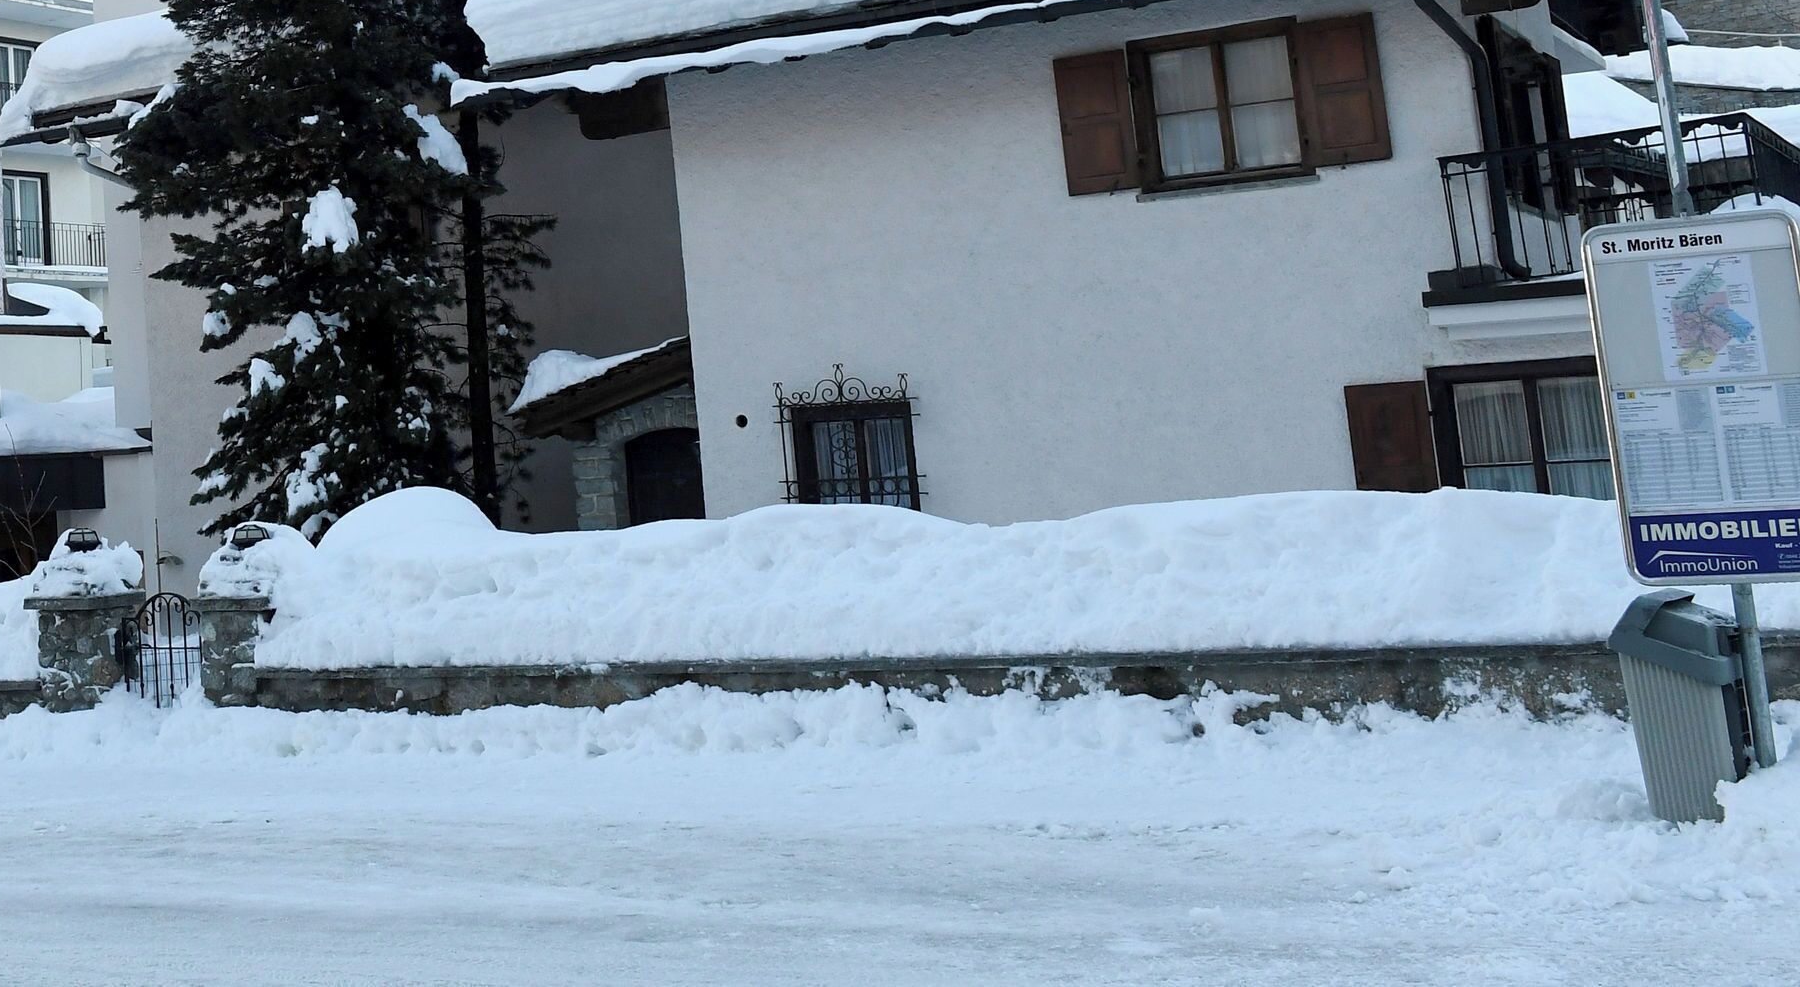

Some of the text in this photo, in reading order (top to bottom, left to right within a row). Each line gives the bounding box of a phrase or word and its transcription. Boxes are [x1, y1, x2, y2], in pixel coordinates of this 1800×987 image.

[1601, 233, 1722, 254] St. Moritz Bären
[1640, 518, 1800, 542] IMMOBILIE
[1659, 557, 1758, 573] ImmoUnion
